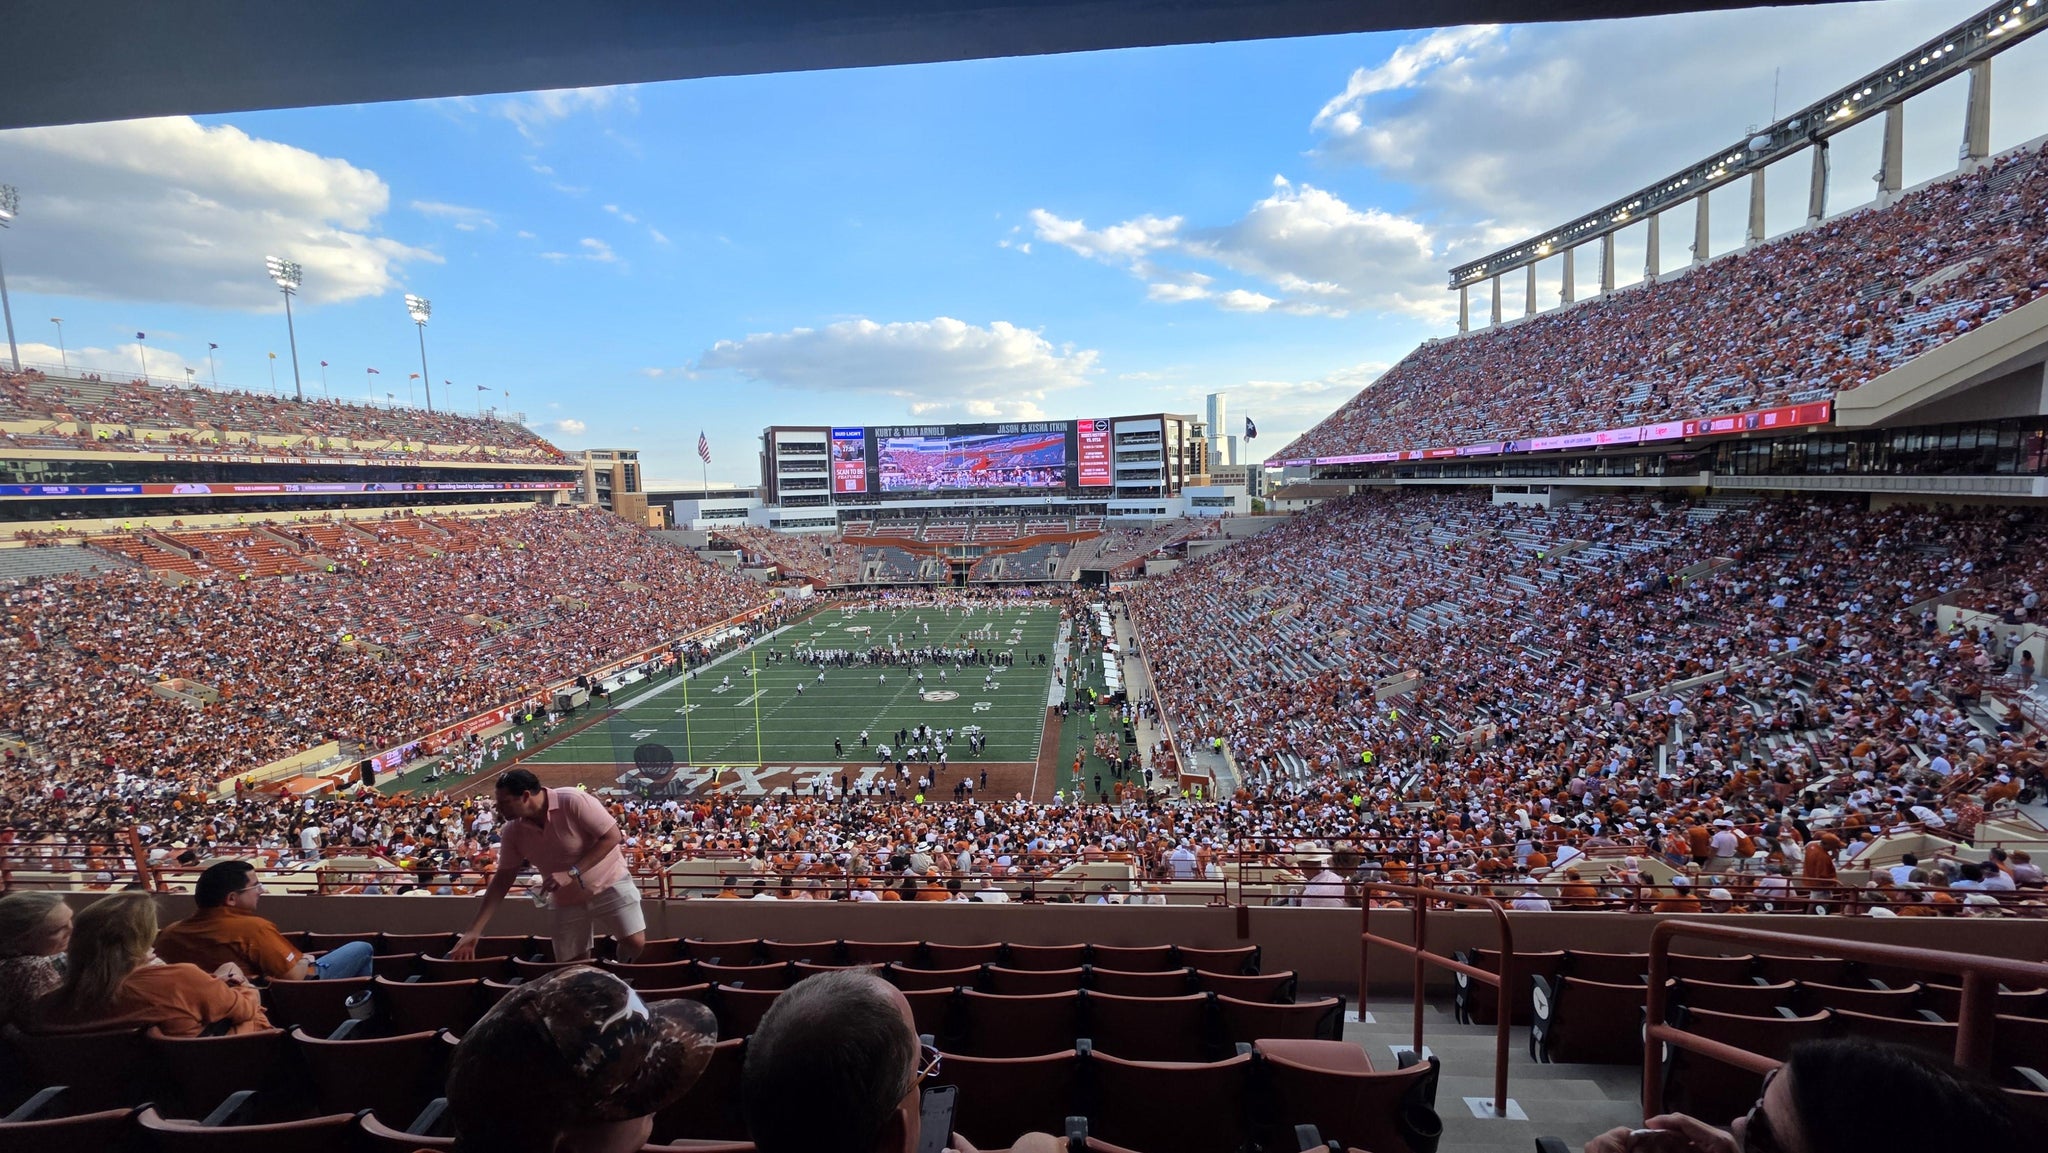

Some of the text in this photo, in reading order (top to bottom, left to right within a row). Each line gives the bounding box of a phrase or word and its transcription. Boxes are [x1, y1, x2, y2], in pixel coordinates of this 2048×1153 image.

[875, 427, 945, 437] KURT & TARA ARNOLD
[997, 422, 1068, 434] JASON & KISHA ITKIN
[836, 468, 850, 476] SCAN
